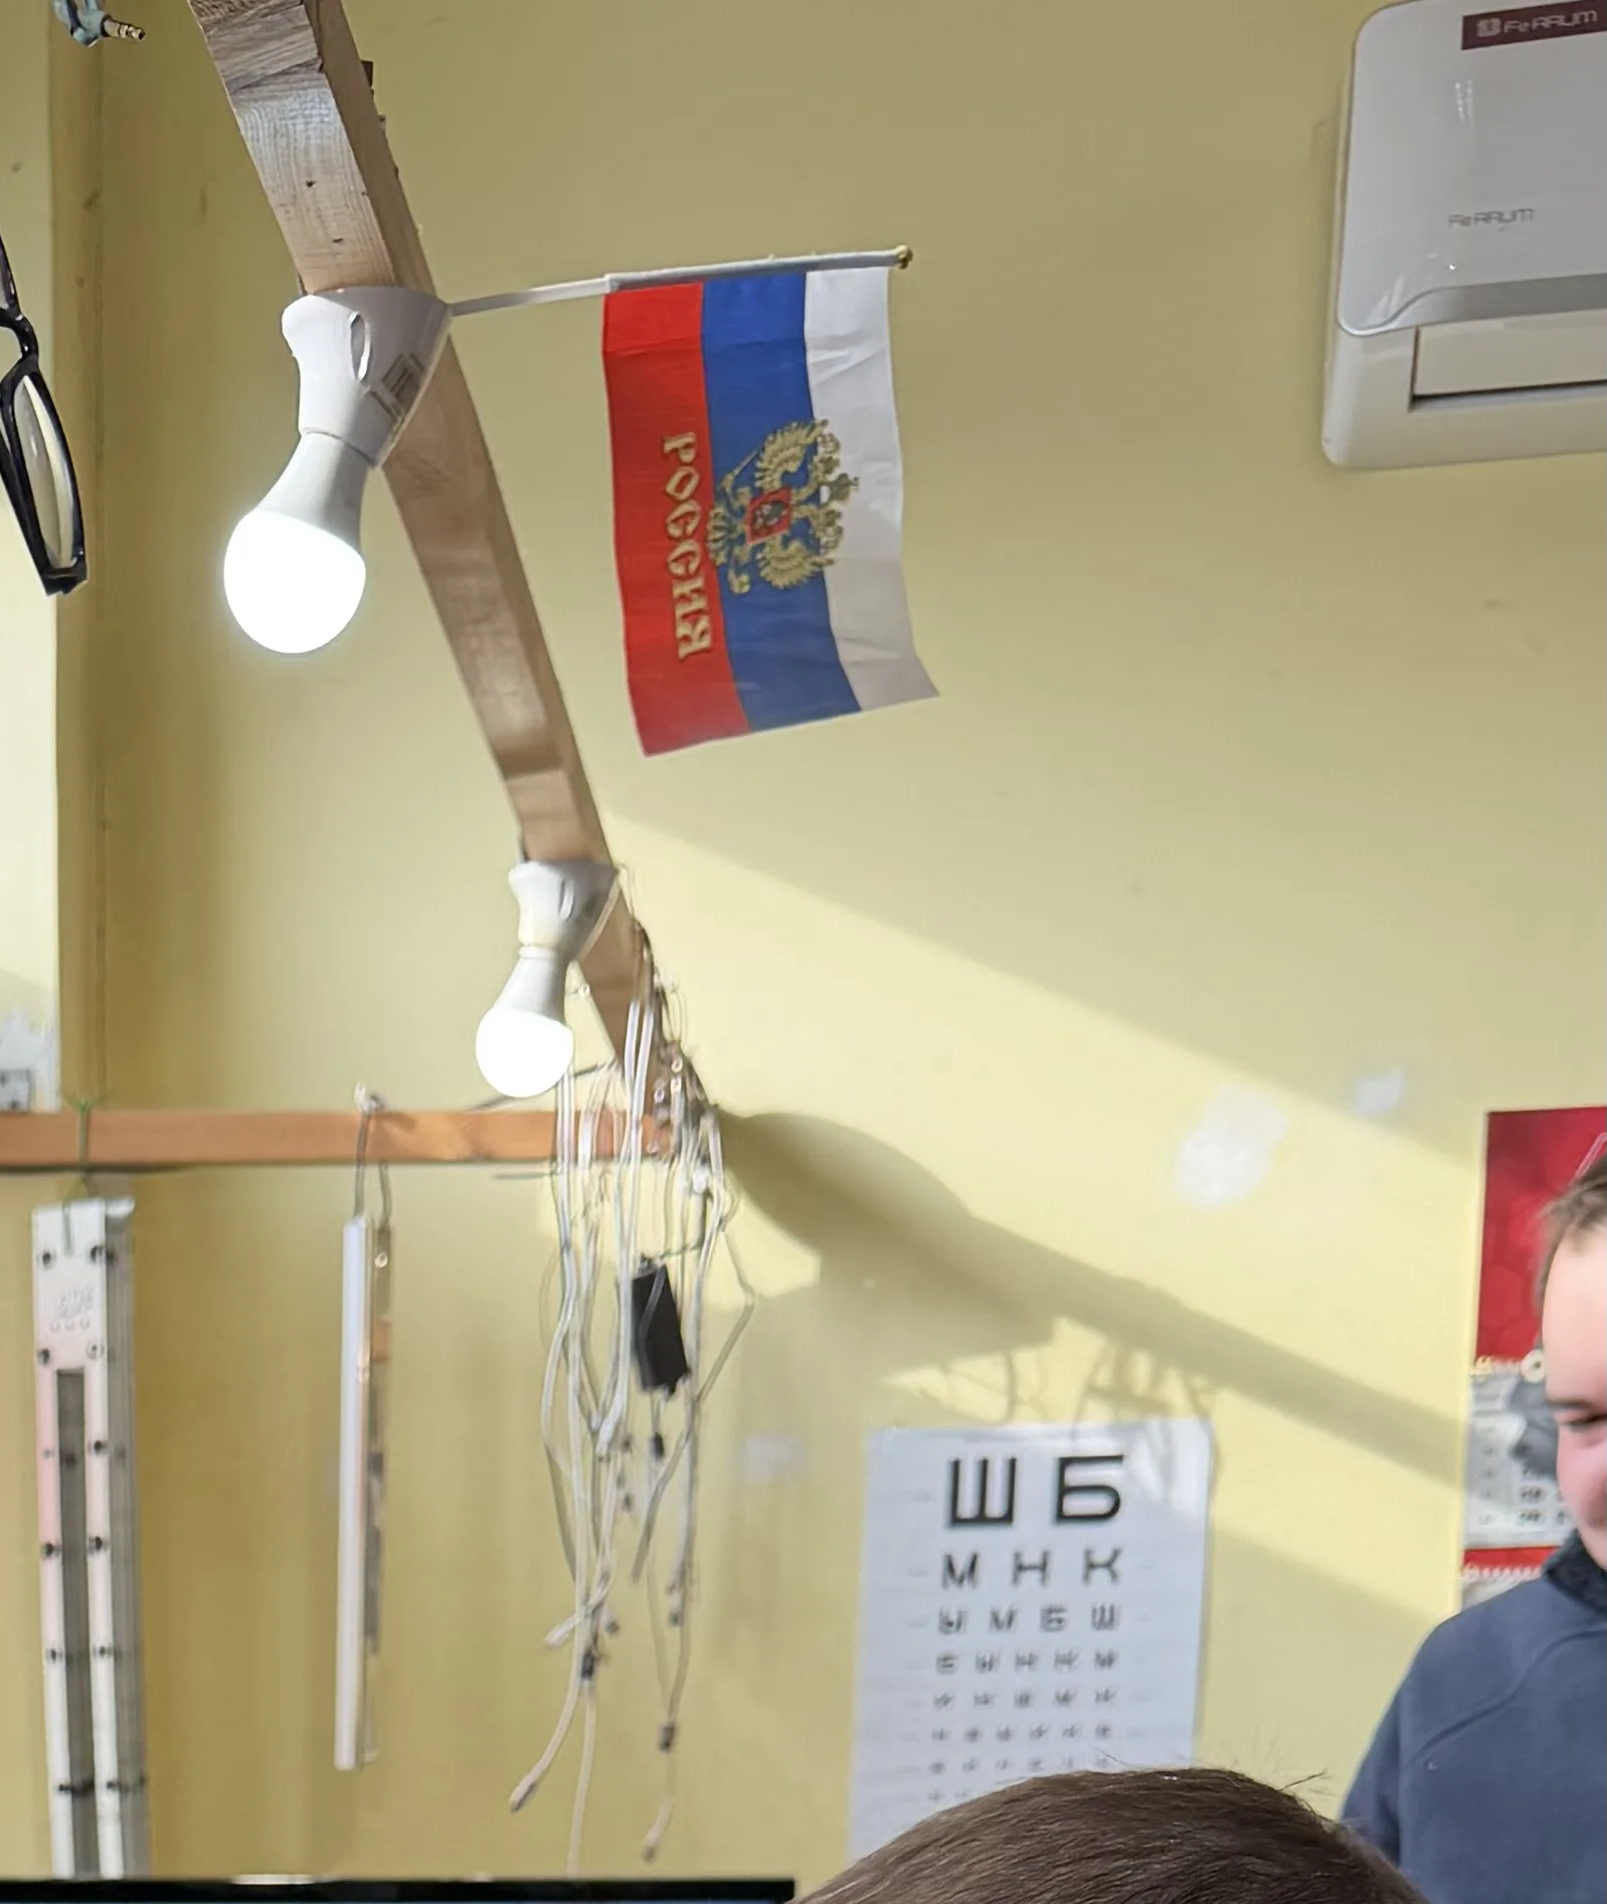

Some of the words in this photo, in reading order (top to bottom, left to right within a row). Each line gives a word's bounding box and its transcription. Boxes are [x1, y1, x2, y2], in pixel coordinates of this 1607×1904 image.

[662, 430, 714, 661] РОССИЯ
[947, 1457, 1017, 1528] Ш
[1053, 1454, 1124, 1525] Б
